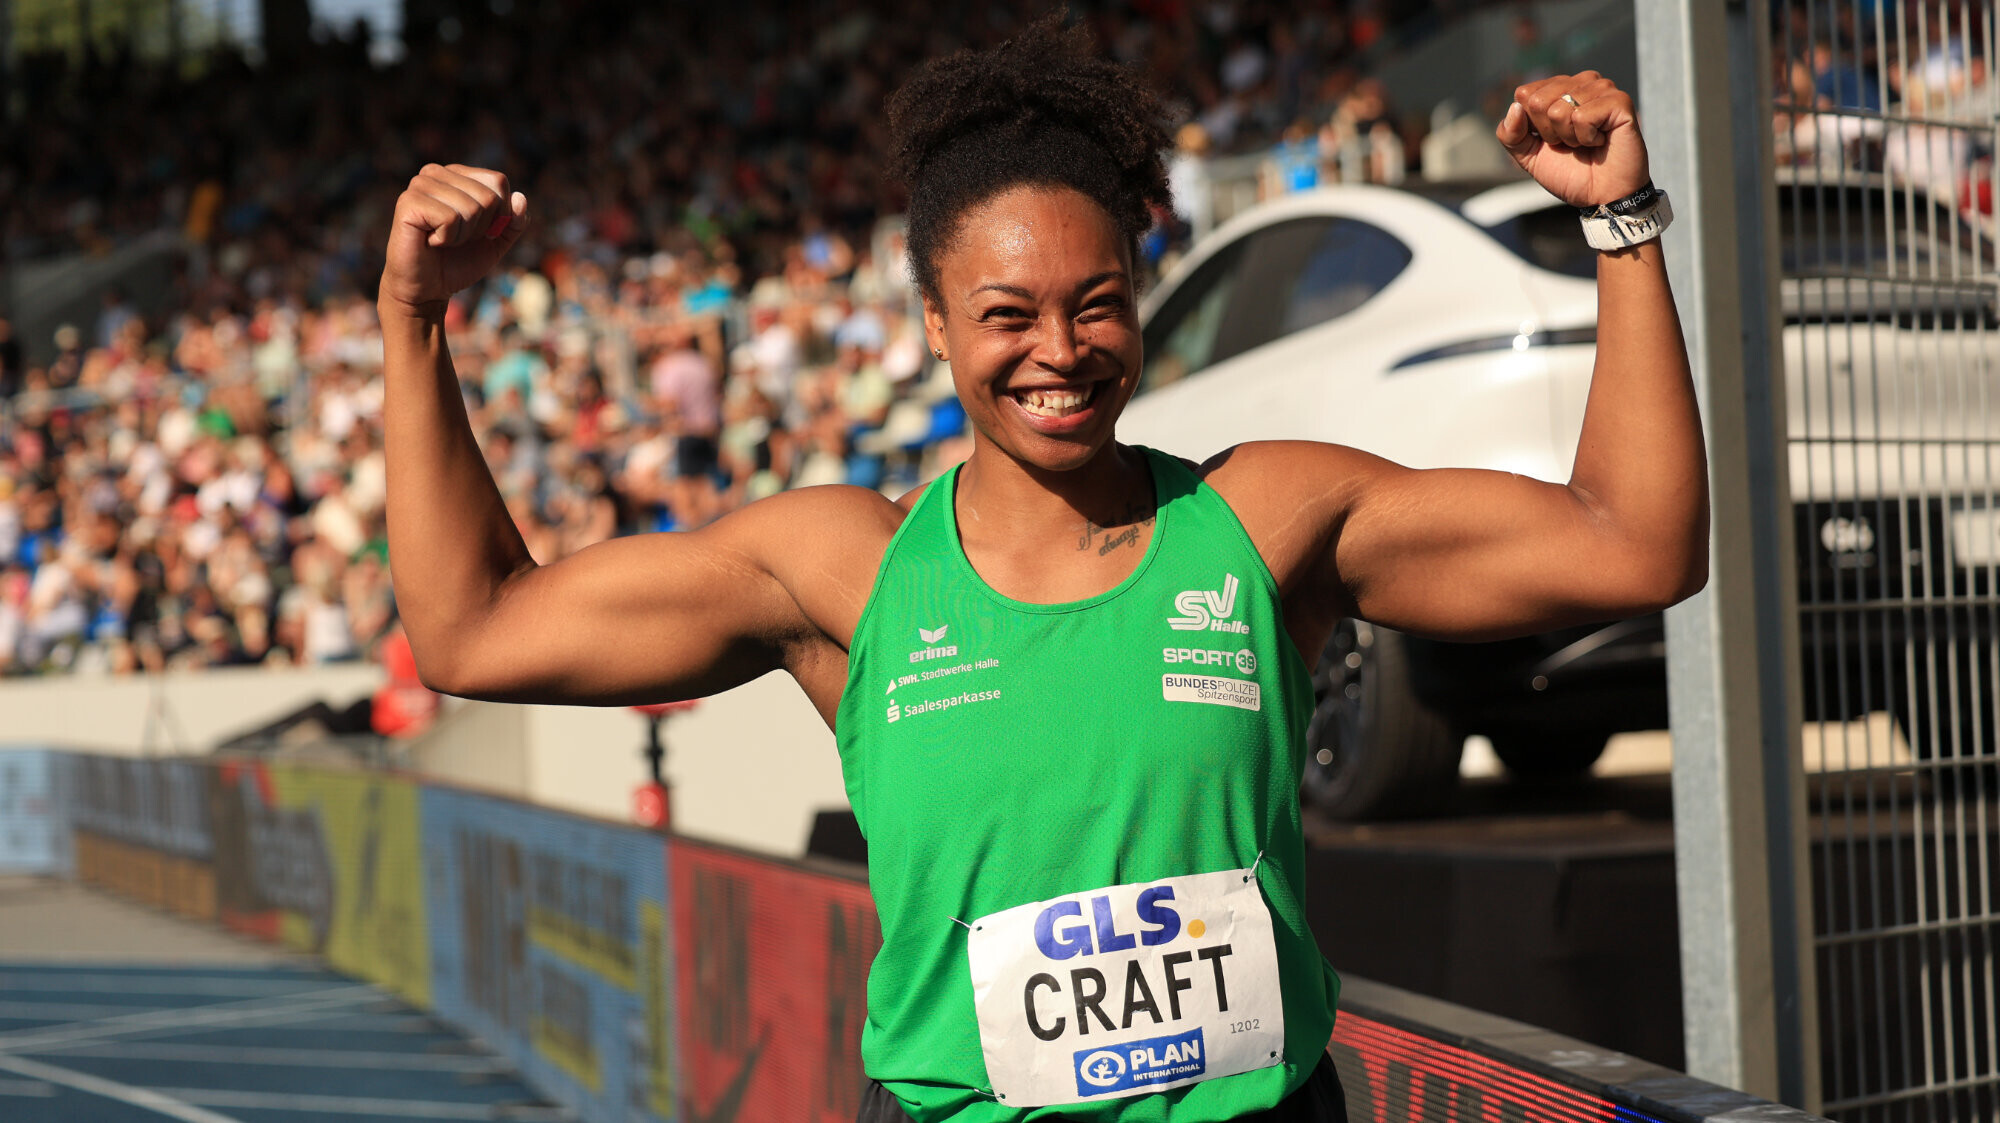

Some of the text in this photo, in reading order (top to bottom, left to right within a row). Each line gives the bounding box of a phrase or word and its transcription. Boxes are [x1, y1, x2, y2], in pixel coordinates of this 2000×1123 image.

[1098, 524, 1141, 557] always
[1167, 572, 1239, 631] SV
[1209, 619, 1250, 635] Halle
[909, 645, 957, 663] erima
[1162, 647, 1255, 670] SPORT 39
[897, 658, 1000, 687] SWH. Stadtwerke Halle
[1165, 677, 1257, 696] BUNDESPOLIZEI
[1197, 688, 1257, 706] Spitzensport
[904, 689, 1001, 717] Saalesparkasse
[1023, 943, 1233, 1042] CRAFT
[1230, 1018, 1260, 1034] 1202
[1130, 1039, 1200, 1071] PLAN
[1133, 1063, 1200, 1081] INTERNATIONAL
